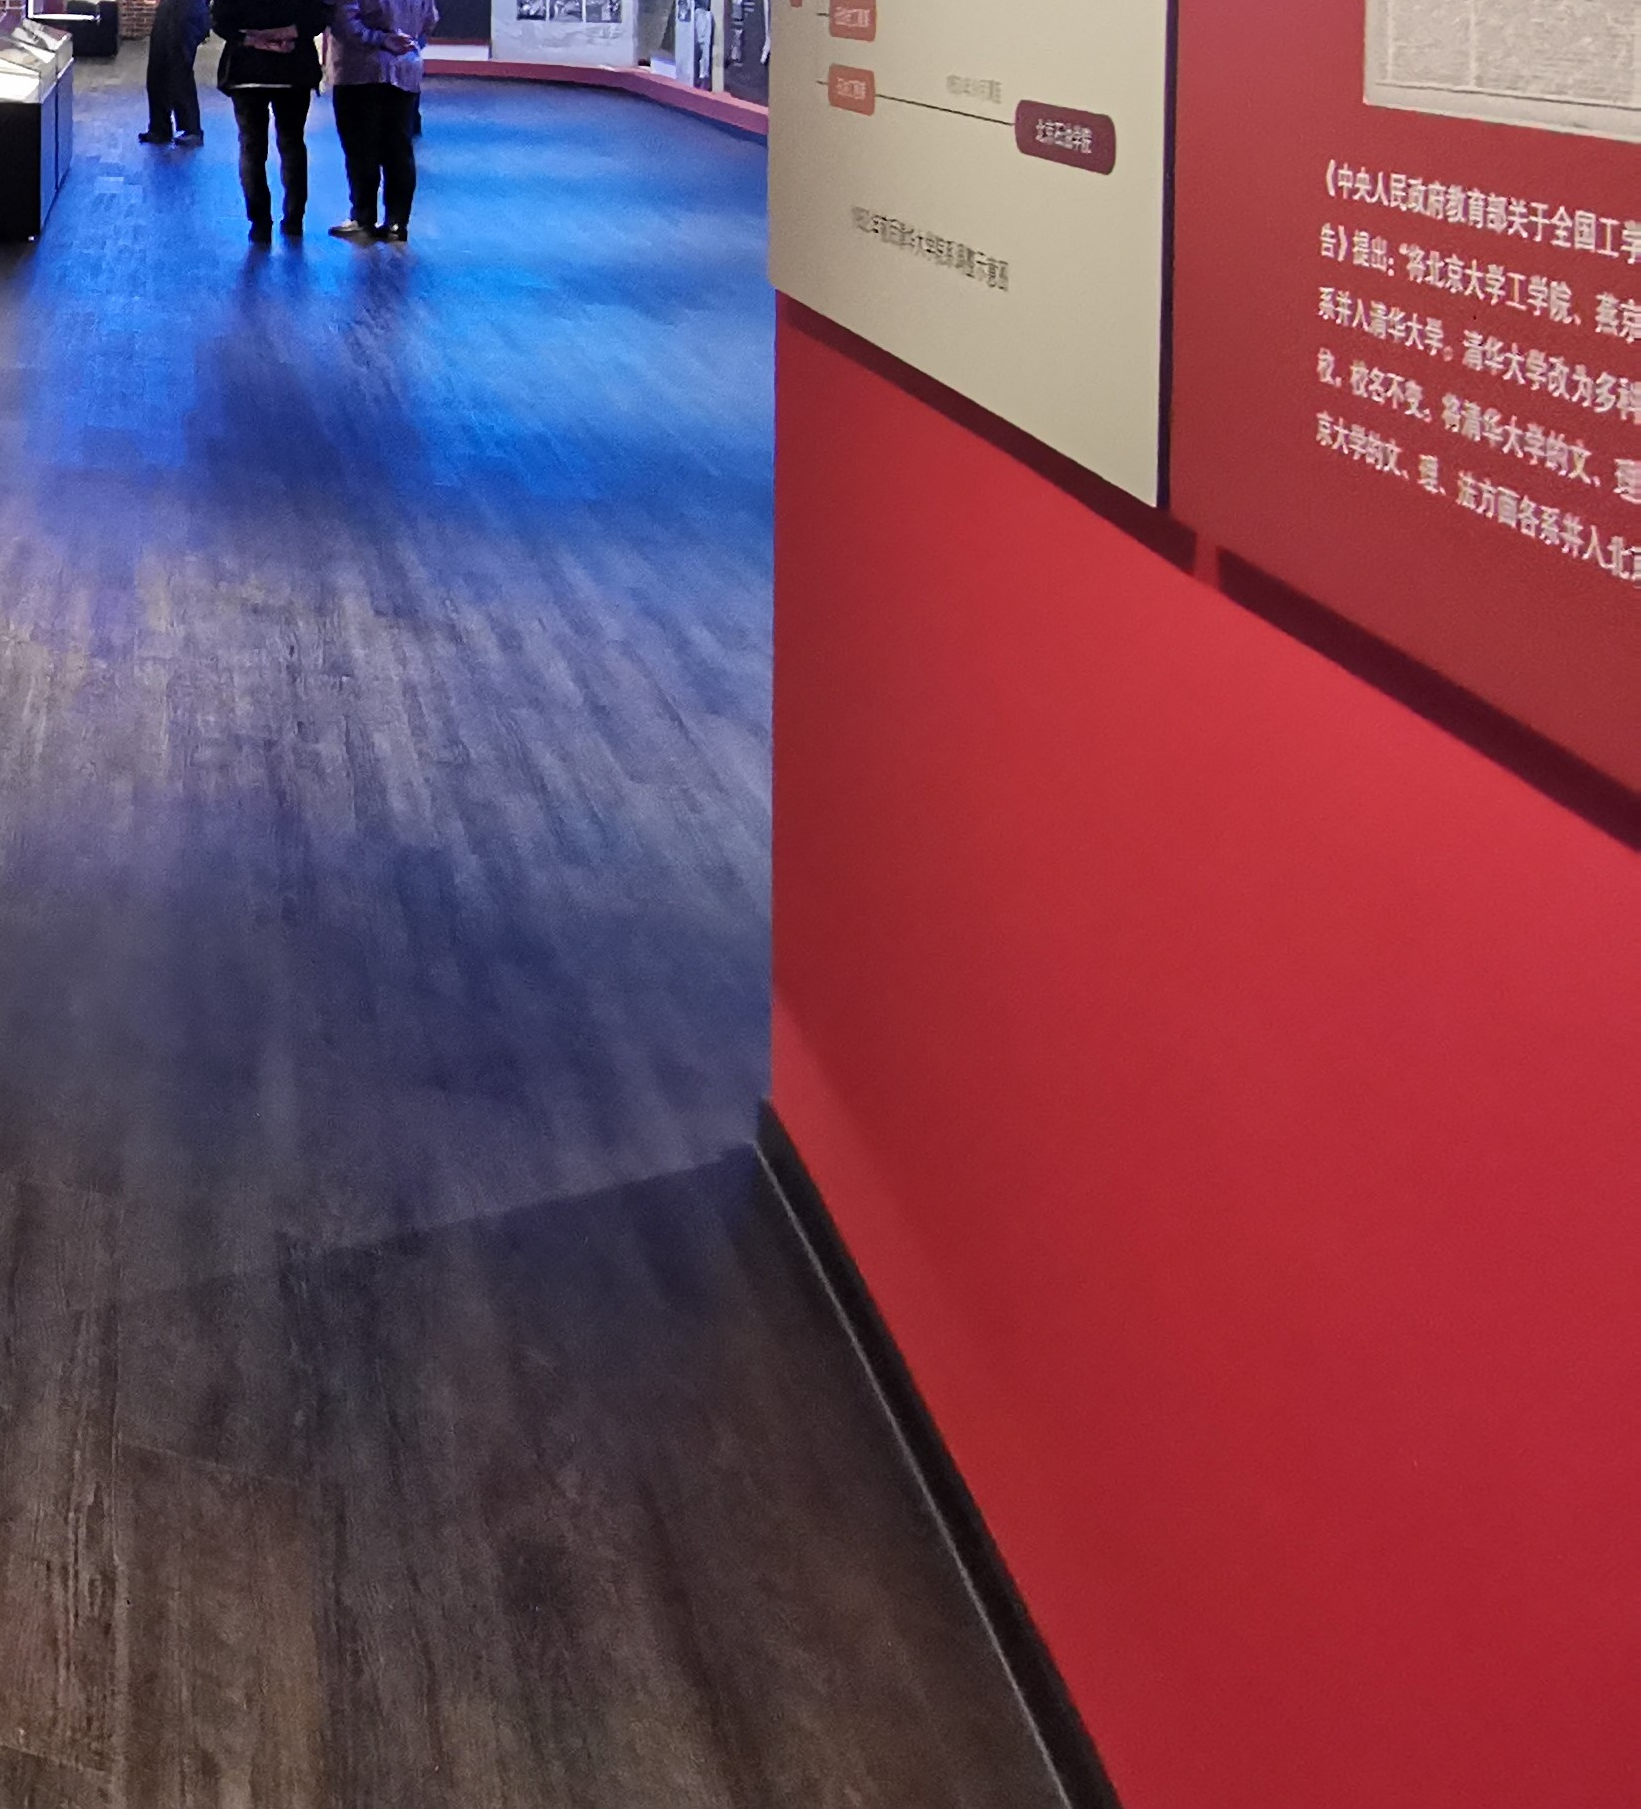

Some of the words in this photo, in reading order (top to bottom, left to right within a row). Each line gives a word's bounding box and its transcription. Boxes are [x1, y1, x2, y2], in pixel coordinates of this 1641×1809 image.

[1317, 410, 1641, 581] 京大学的文、理、法方面各系并入北
